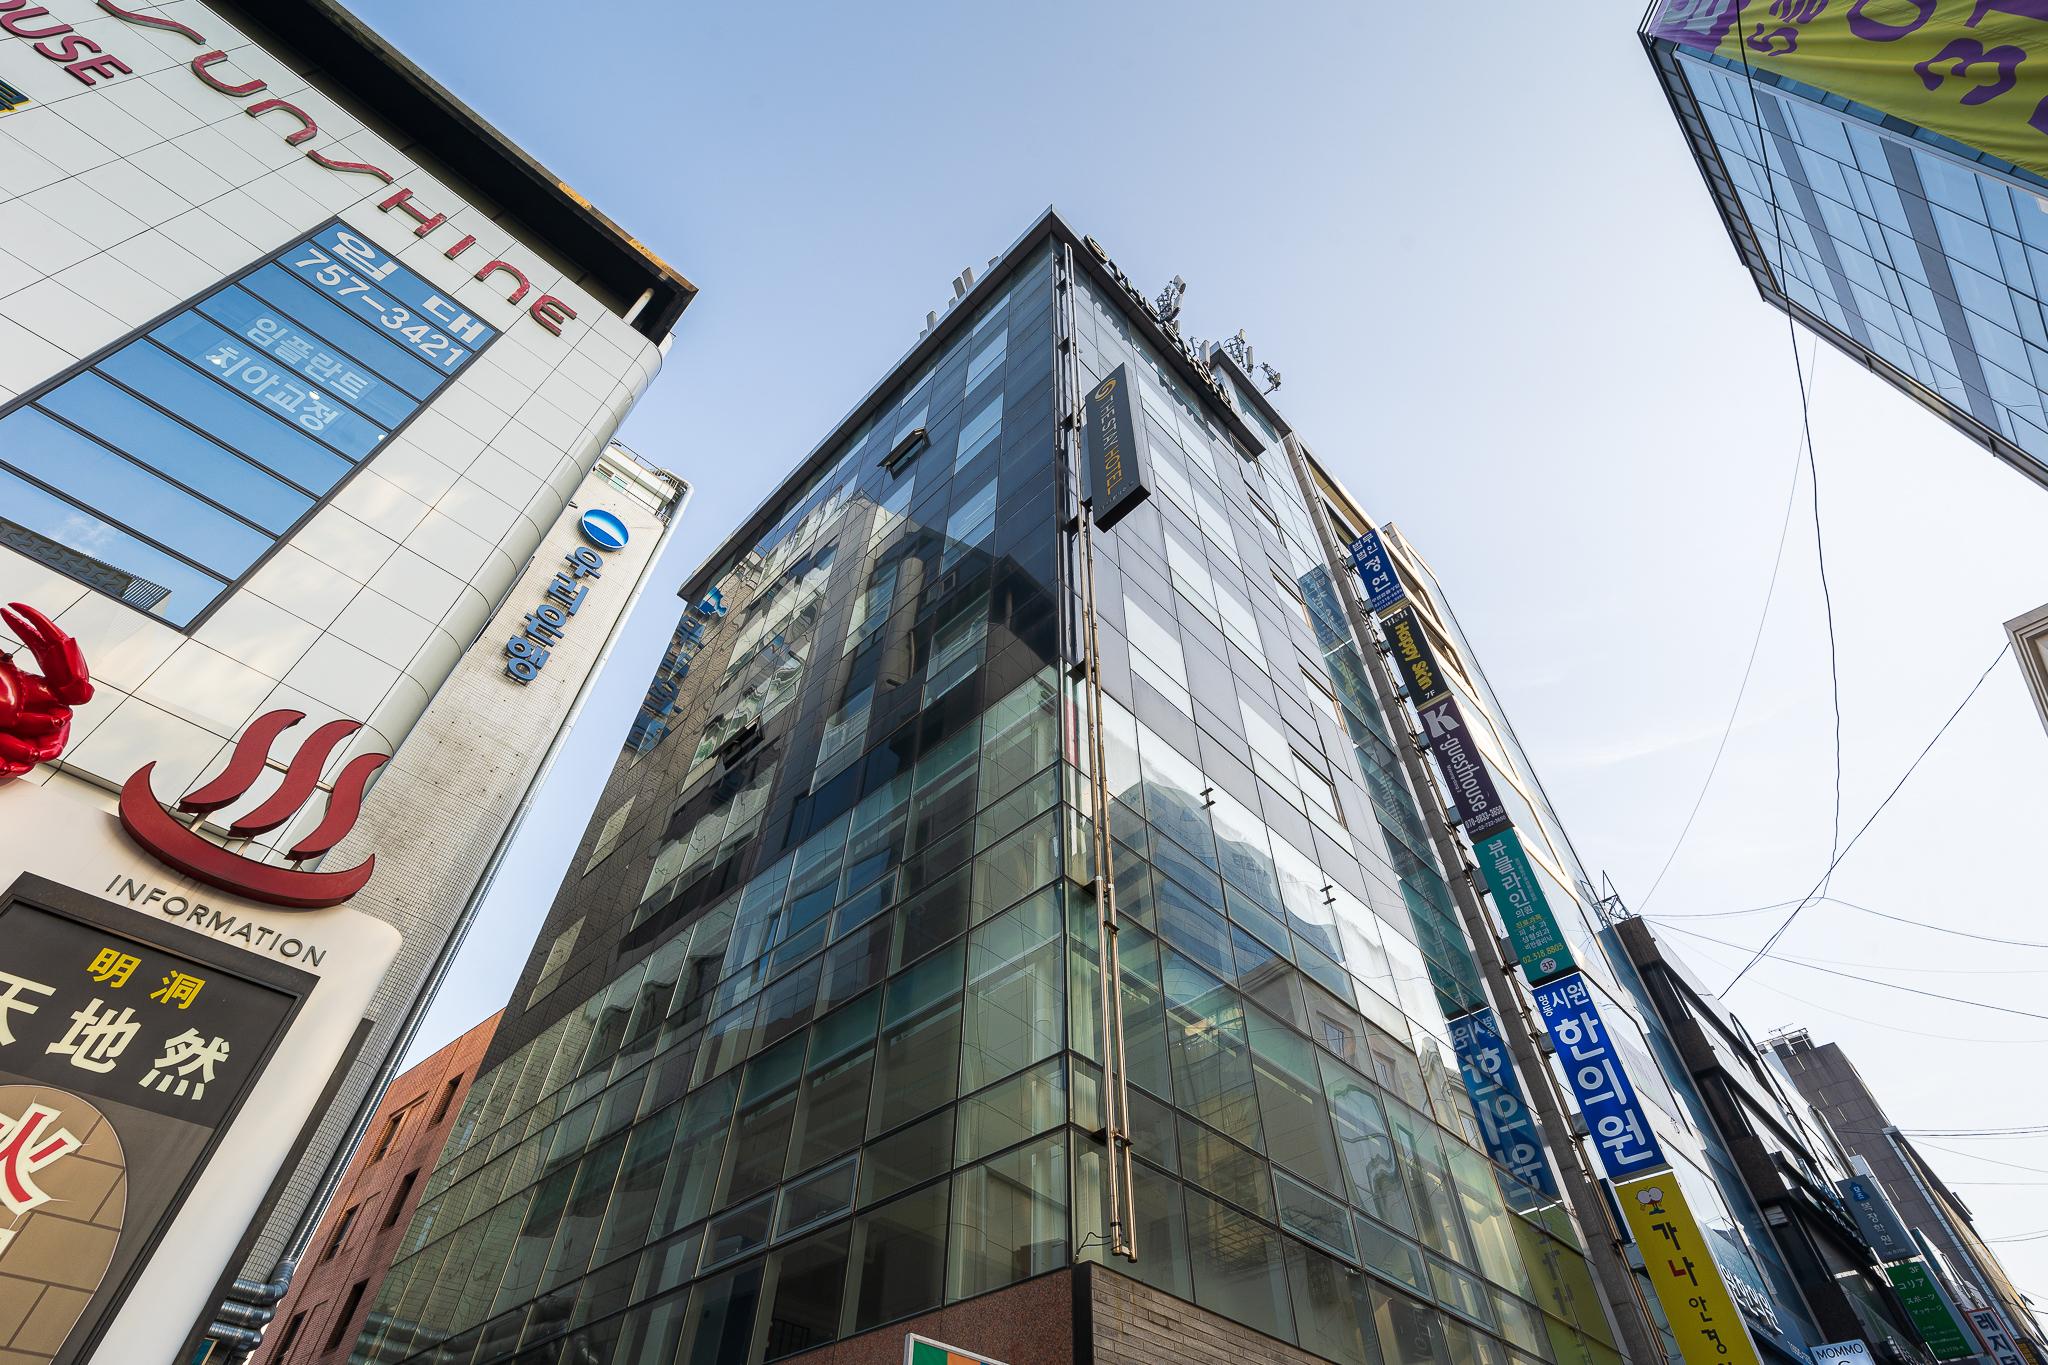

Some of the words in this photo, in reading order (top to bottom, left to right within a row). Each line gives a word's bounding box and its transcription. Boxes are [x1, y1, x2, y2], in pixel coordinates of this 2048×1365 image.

[295, 249, 468, 367] 757-3421
[205, 346, 340, 431] 치아교정
[246, 317, 370, 400] 임플란트
[1365, 555, 1391, 593] 정연
[504, 546, 604, 687] 우리은행
[1394, 621, 1420, 662] Happy
[1412, 660, 1433, 691] Skin
[1424, 689, 1436, 700] 7F
[105, 873, 327, 968] INFORMATION
[86, 947, 207, 1010] 明洞
[1540, 960, 1555, 972] 3F
[1552, 981, 1589, 1009] 시원
[1555, 1012, 1653, 1165] 한의원
[1897, 1278, 1924, 1290] コリア
[1908, 1294, 1935, 1305] スポーツ
[1688, 1296, 1734, 1365] 안경
[1816, 1343, 1864, 1360] MOMMO
